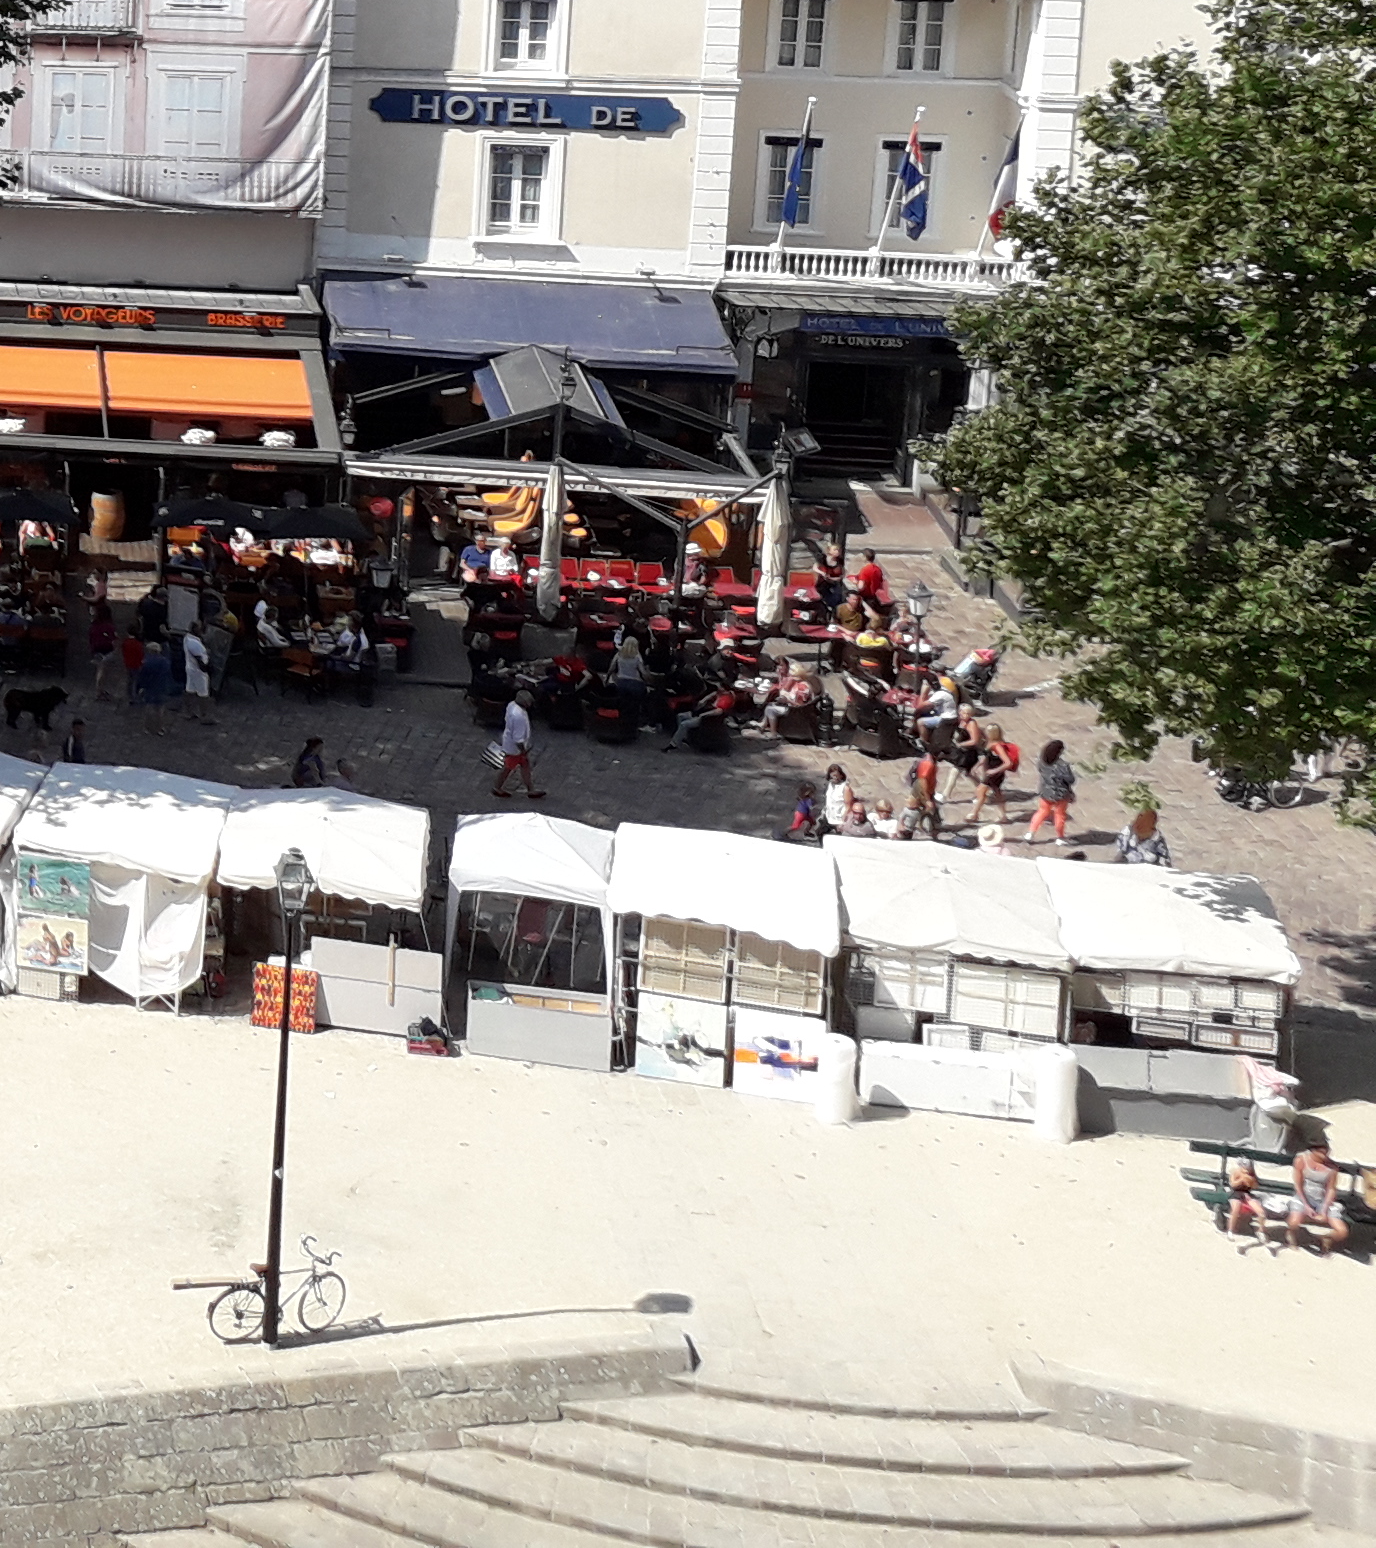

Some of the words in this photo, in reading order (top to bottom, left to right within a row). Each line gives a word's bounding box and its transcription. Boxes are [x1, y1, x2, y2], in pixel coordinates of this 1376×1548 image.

[411, 93, 563, 125] HOTEL
[590, 105, 637, 127] DE
[26, 304, 53, 320] LES
[60, 306, 156, 324] VOYAGEURS
[207, 313, 287, 328] BRASSERIE
[836, 335, 904, 348] L'UNIVERS
